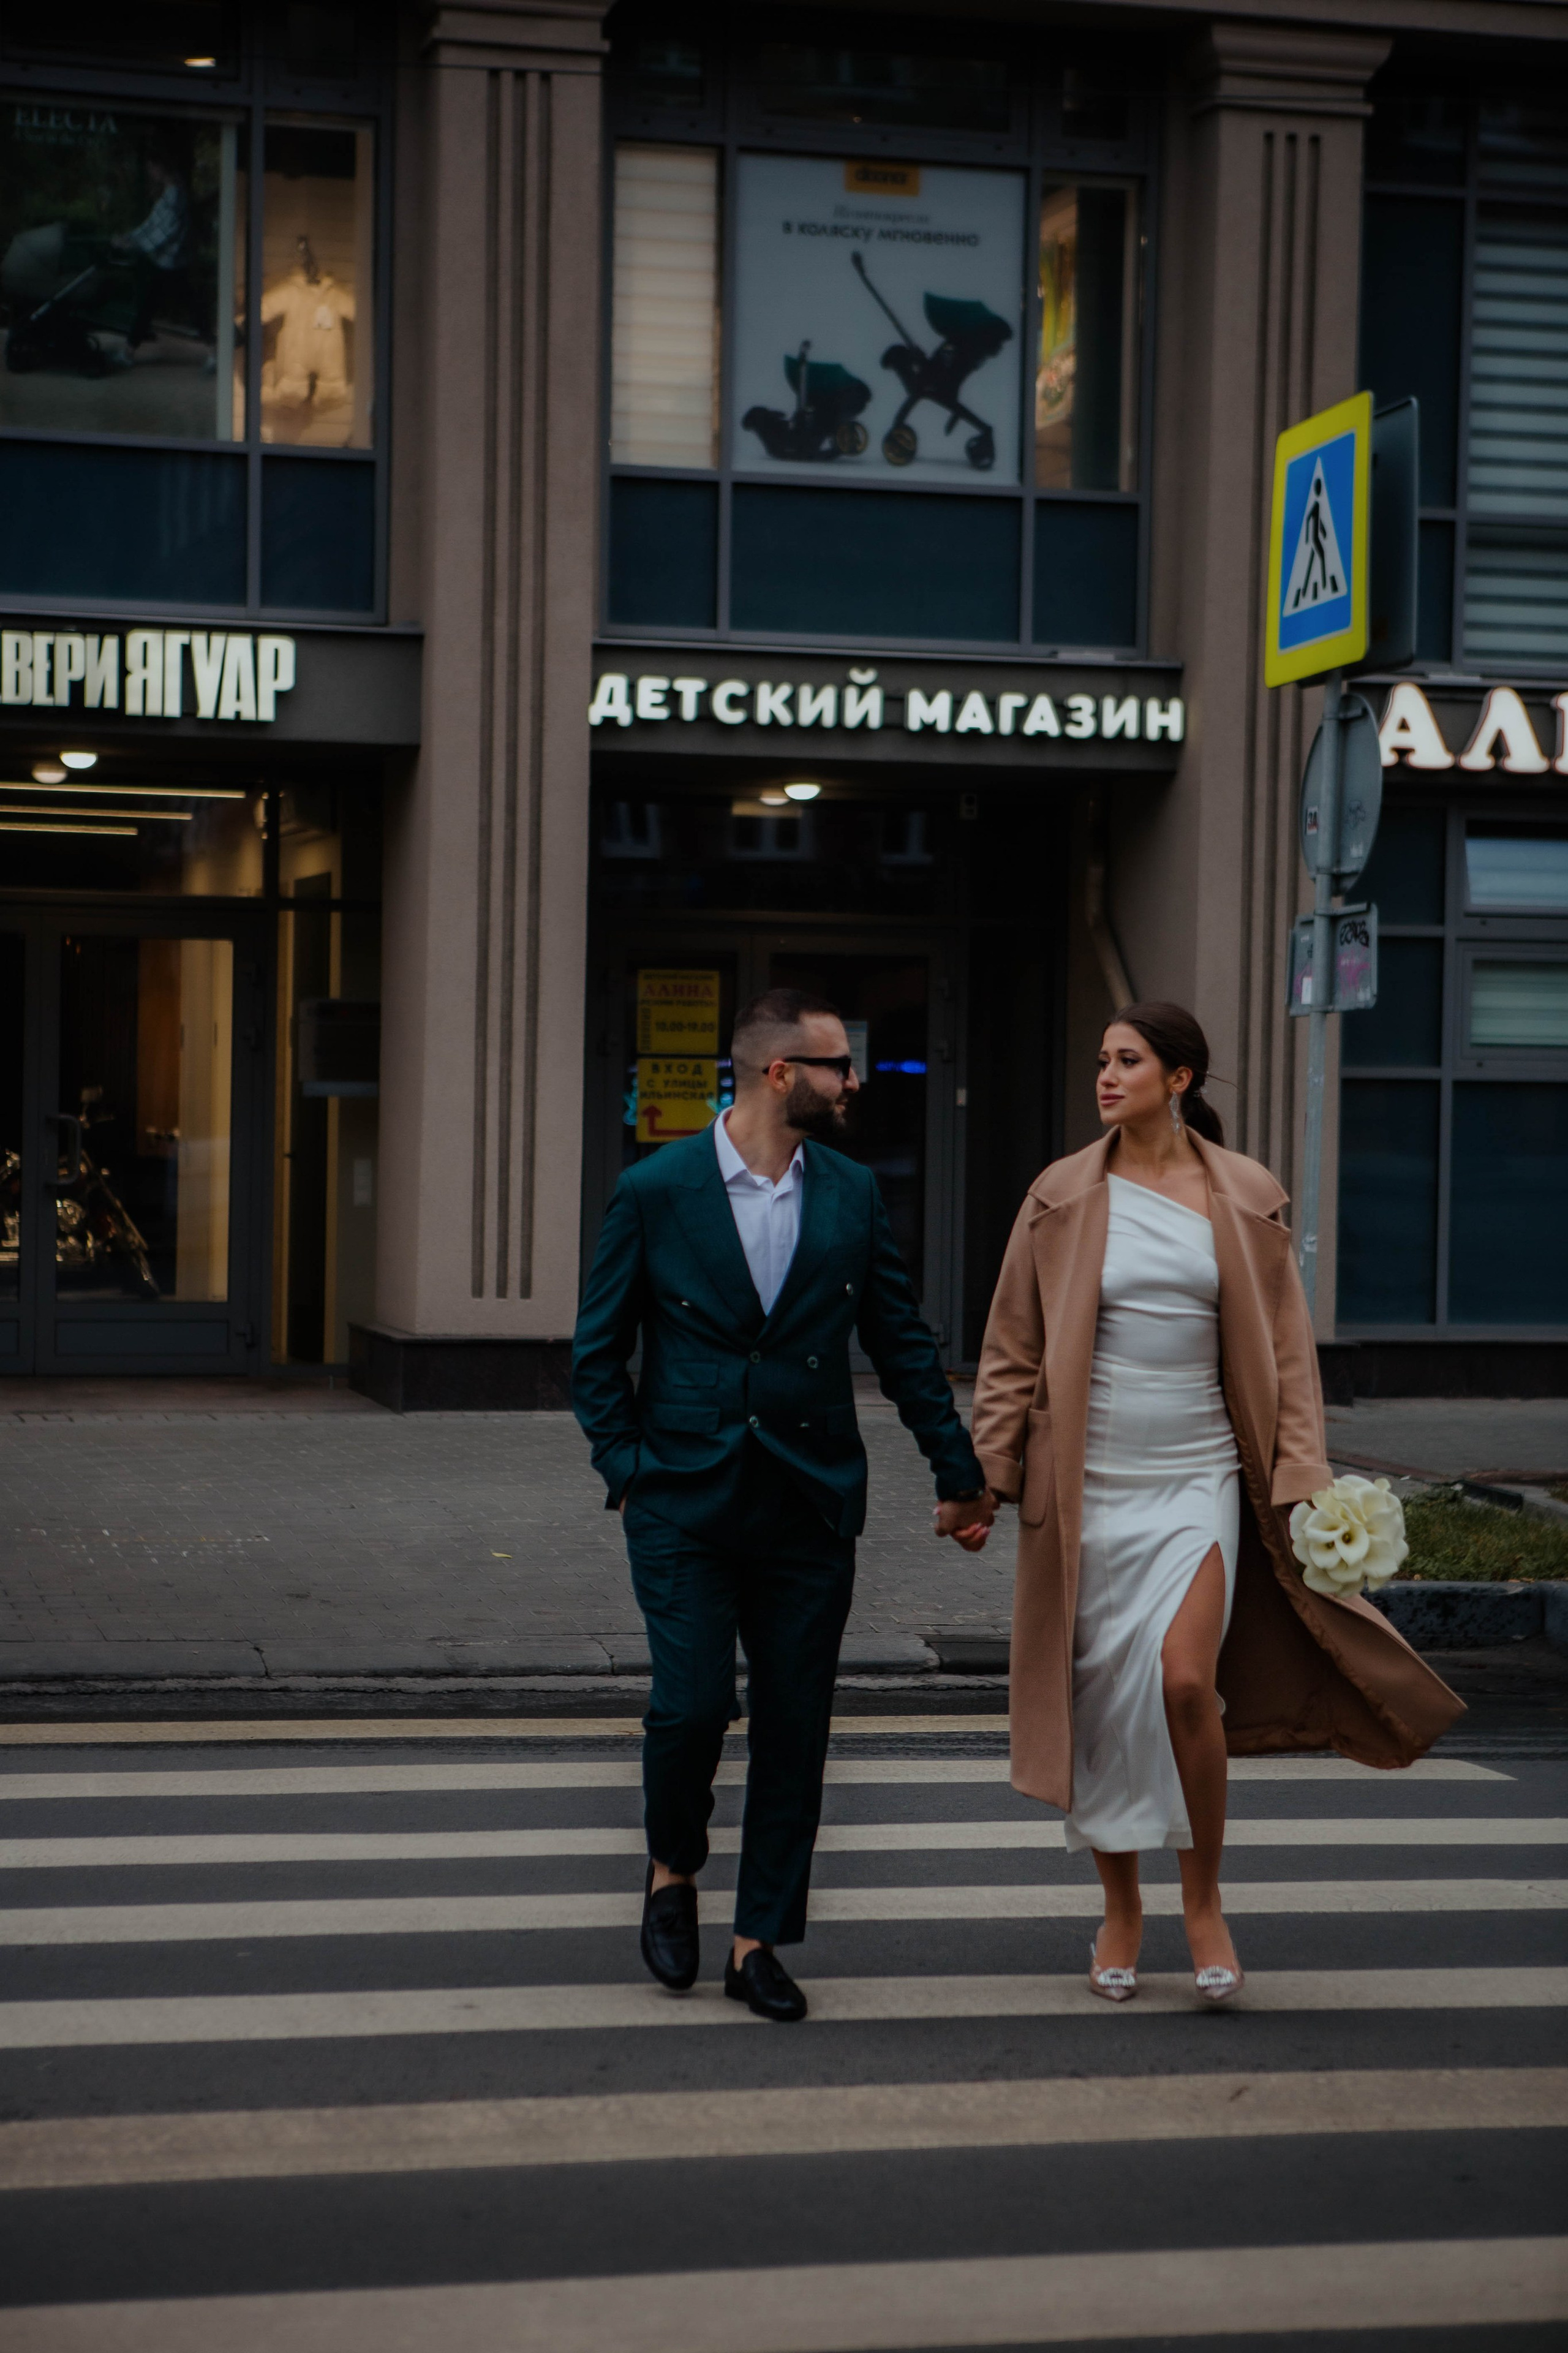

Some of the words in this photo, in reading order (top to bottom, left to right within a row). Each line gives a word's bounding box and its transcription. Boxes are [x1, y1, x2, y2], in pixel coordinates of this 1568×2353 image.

[0, 629, 120, 709] ВЕРИ
[125, 629, 296, 722] ЯГУАР
[588, 667, 884, 730] ДЕТСКИЙ
[907, 689, 1185, 742] МАГАЗИН
[1378, 681, 1568, 776] АЛ
[643, 983, 714, 998] АЛИНА
[647, 1079, 655, 1089] С
[663, 1079, 708, 1089] УЛИЦЫ
[652, 1063, 703, 1075] ВХОД
